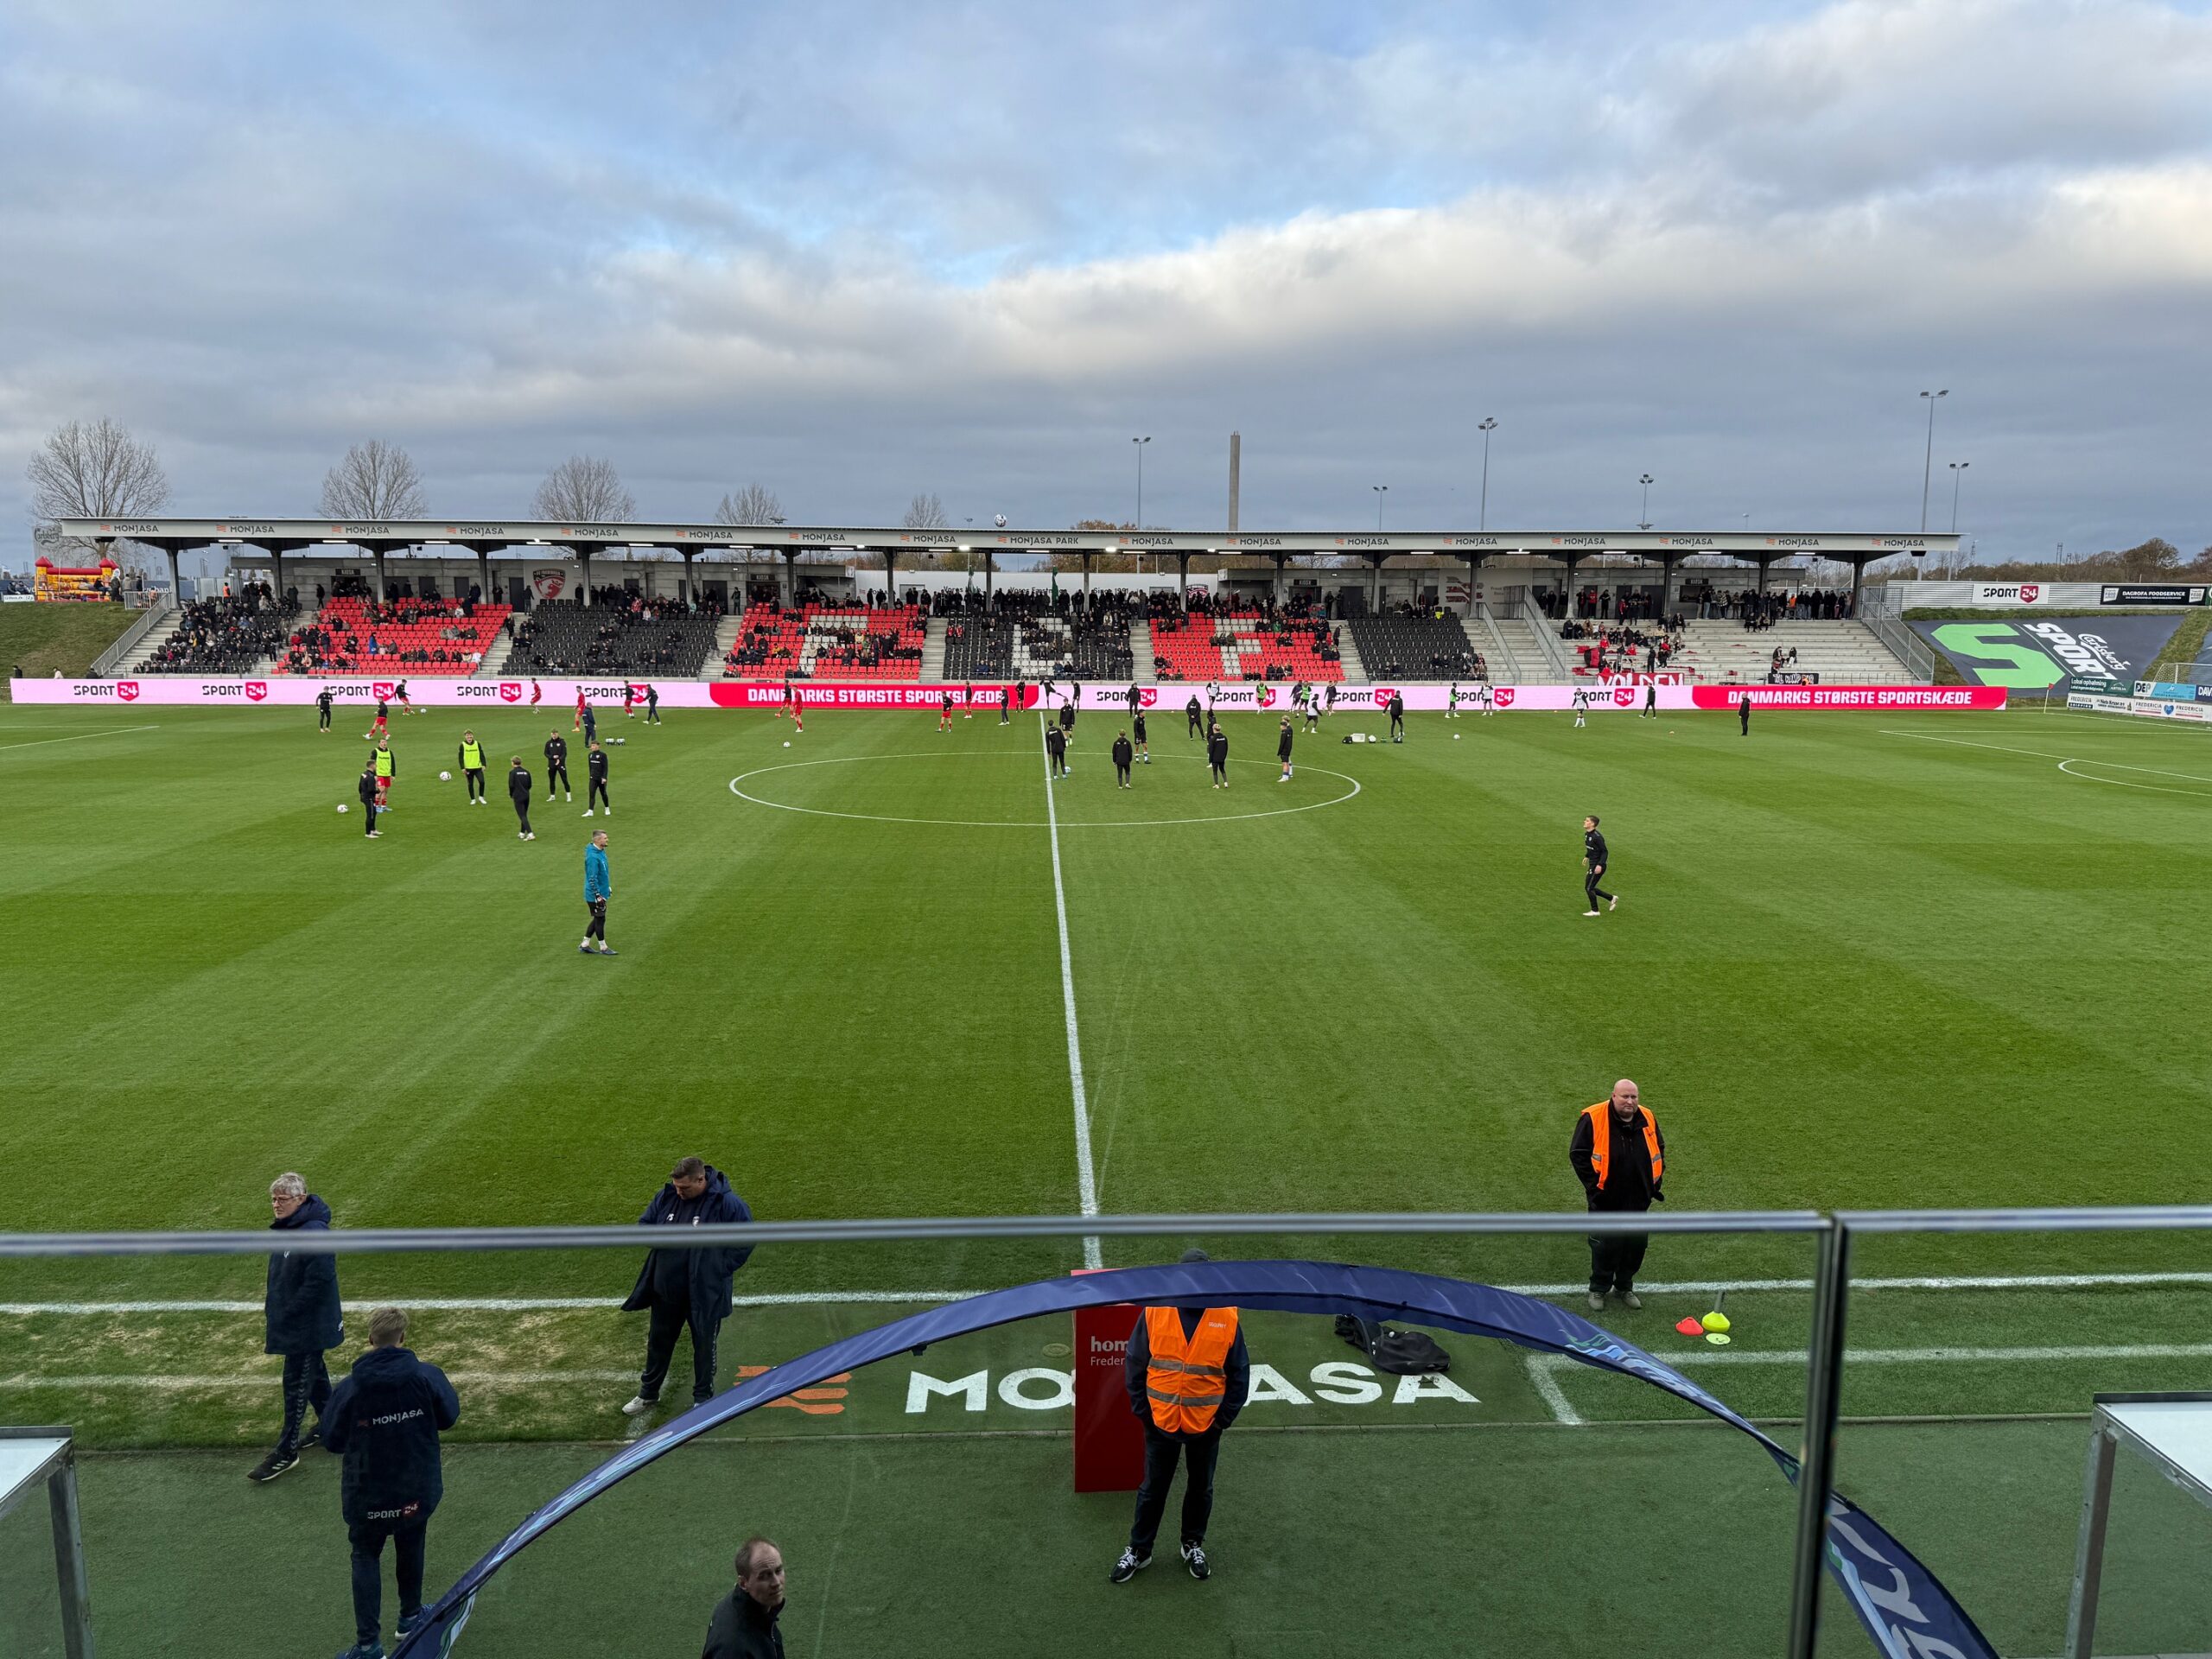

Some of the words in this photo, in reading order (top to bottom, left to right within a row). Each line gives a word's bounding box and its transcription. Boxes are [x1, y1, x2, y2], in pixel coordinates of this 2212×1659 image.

[114, 524, 159, 533] MONJASA
[230, 524, 276, 533] MONJASA
[346, 525, 390, 535] MONJASA
[461, 527, 505, 536] MONJASA
[575, 529, 620, 537] MONJASA
[690, 531, 733, 539] MONJASA
[803, 533, 846, 542] MONJASA
[914, 536, 957, 544] MONJASA
[1010, 537, 1052, 545] MONJASA
[1132, 537, 1174, 546] MONJASA
[1240, 537, 1281, 546] MONJASA
[1348, 537, 1389, 546] MONJASA
[1456, 537, 1497, 546] MONJASA
[1564, 537, 1606, 546] MONJASA
[1672, 537, 1713, 546] MONJASA
[1779, 538, 1820, 547] MONJASA
[1885, 538, 1924, 547] MONJASA
[1983, 588, 2018, 598] SPORT
[2022, 587, 2037, 599] 24
[2023, 622, 2118, 680] SPORT
[2078, 633, 2128, 671] Carlsberg
[74, 685, 115, 696] SPORT
[119, 685, 138, 696] 24
[202, 685, 244, 696] SPORT
[247, 685, 266, 696] 24
[330, 686, 371, 696] SPORT
[375, 686, 394, 696] 24
[457, 686, 498, 696] SPORT
[501, 686, 521, 697] 24
[585, 687, 626, 697] SPORT
[632, 688, 648, 698] 24
[838, 689, 902, 702] STØRSTE
[1096, 691, 1128, 702] SPOR
[1140, 691, 1156, 702] 24
[1215, 692, 1254, 702] SPORT
[1335, 692, 1373, 702] SPORT
[1377, 691, 1395, 702] 24
[1455, 692, 1484, 702] SPOR
[1497, 691, 1513, 702] 24
[1583, 691, 1612, 702] PORT
[1617, 691, 1633, 702] 24
[1728, 690, 1811, 704] DANMARKS
[1814, 691, 1876, 704] STØRSTE
[1878, 691, 1973, 705] SPORTSKÆDE
[1091, 1336, 1129, 1351] hom
[1090, 1357, 1125, 1366] Freder
[906, 1362, 1480, 1413] MOASA
[372, 1408, 423, 1426] MONJASA
[367, 1509, 402, 1519] SPORT
